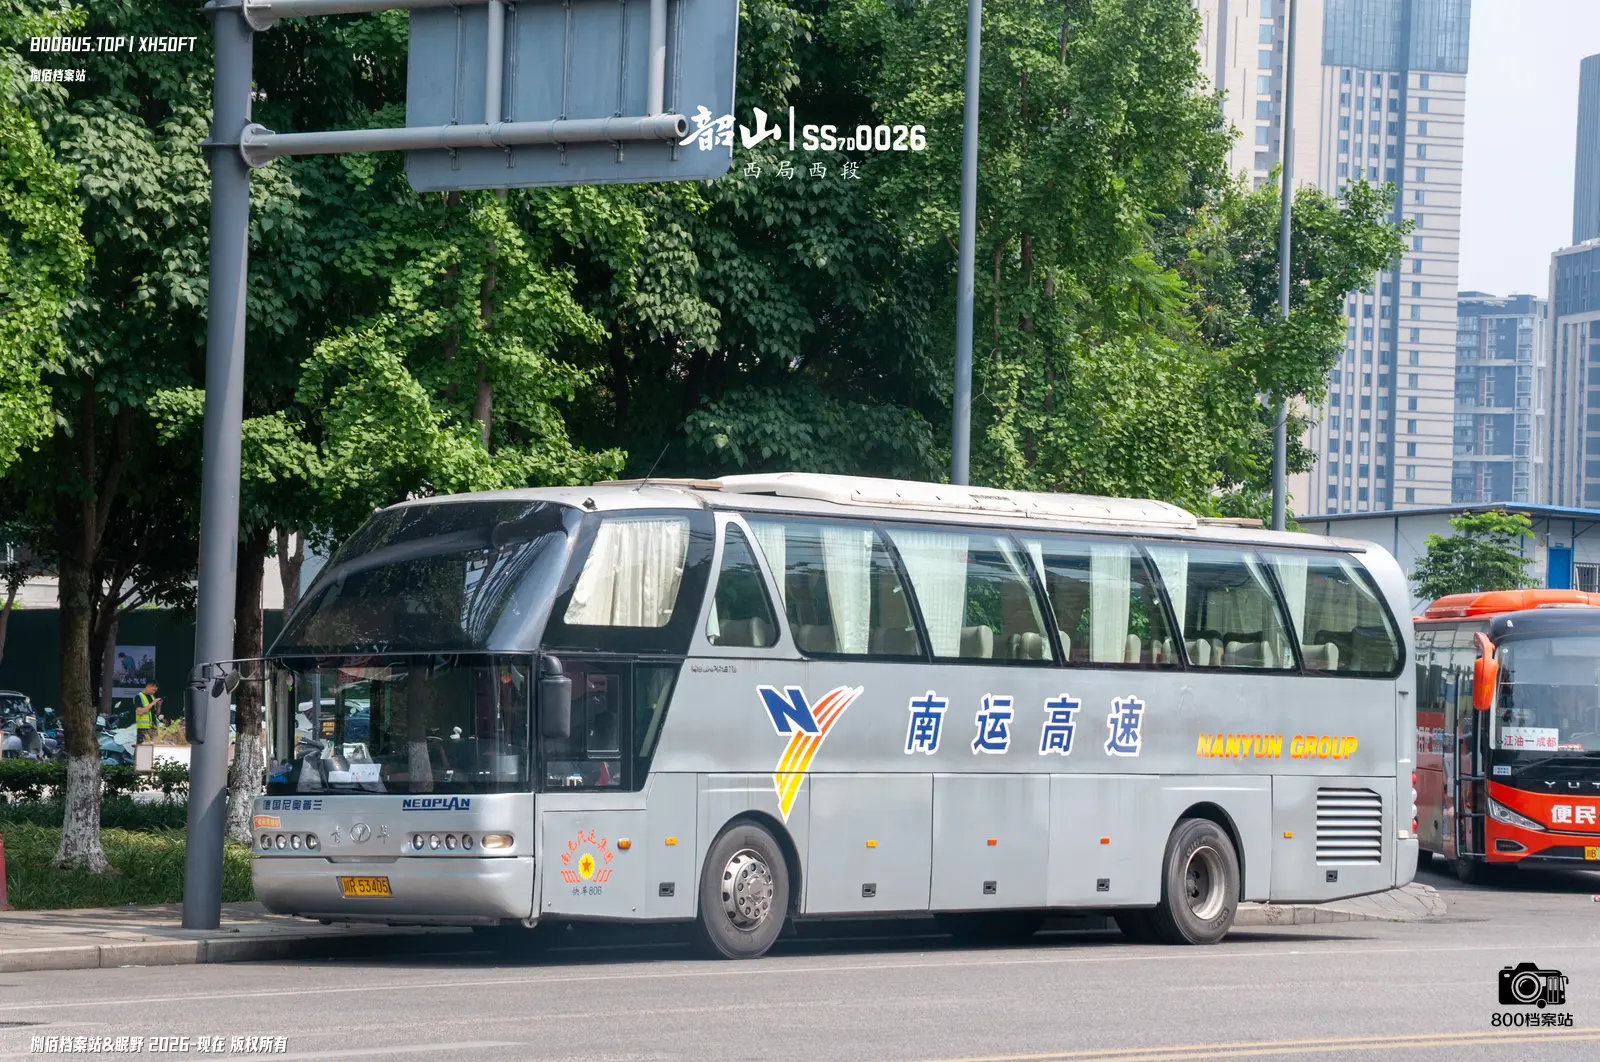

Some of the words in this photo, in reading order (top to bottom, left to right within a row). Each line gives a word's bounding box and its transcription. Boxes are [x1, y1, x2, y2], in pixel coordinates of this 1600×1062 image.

[904, 690, 1146, 757] 南运高速
[1196, 733, 1283, 758] NANYUN
[1290, 735, 1358, 760] GROUP
[402, 797, 470, 810] NEOPLAN
[1551, 804, 1597, 825] 便民
